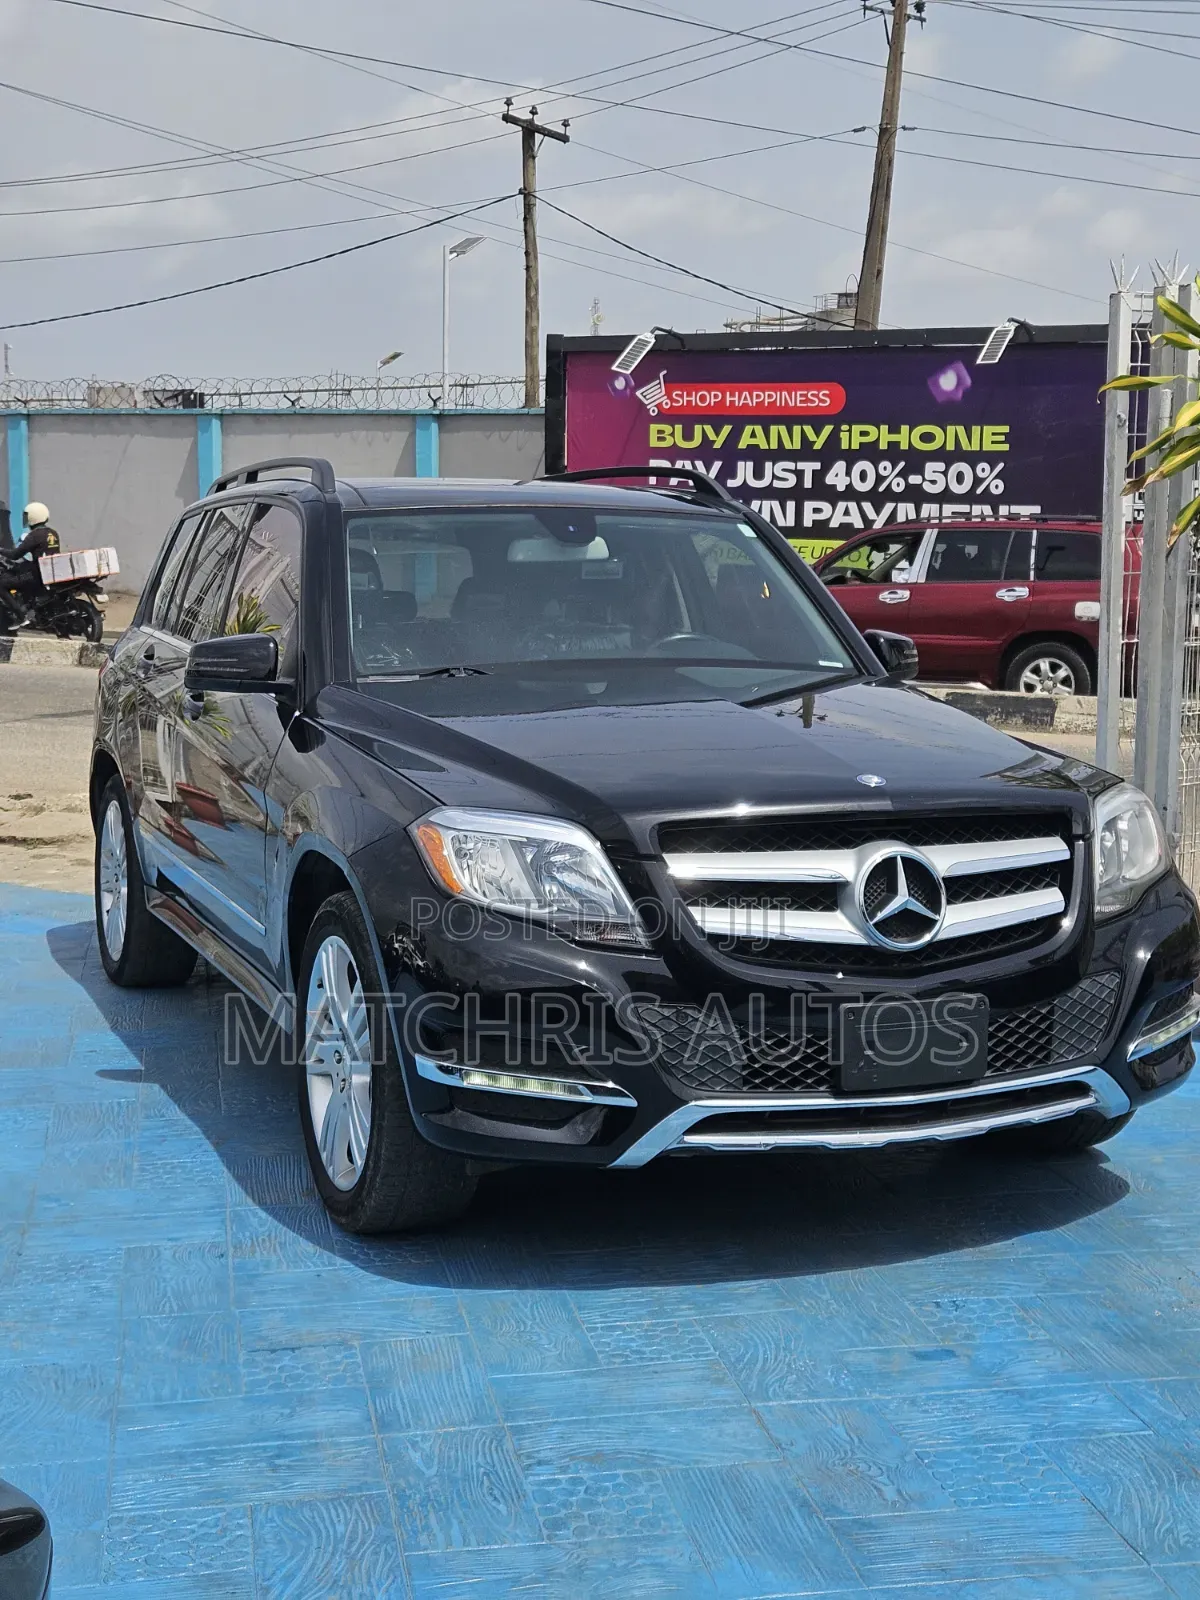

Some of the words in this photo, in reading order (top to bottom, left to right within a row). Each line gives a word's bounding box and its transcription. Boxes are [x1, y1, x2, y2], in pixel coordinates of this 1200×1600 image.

[672, 390, 722, 407] SHOP
[726, 390, 831, 407] HAPPINESS
[649, 424, 733, 449] BUY
[738, 424, 835, 450] ANY
[840, 424, 1010, 451] iPHONE
[727, 461, 822, 489] JUST
[825, 460, 1005, 495] 40%-50%
